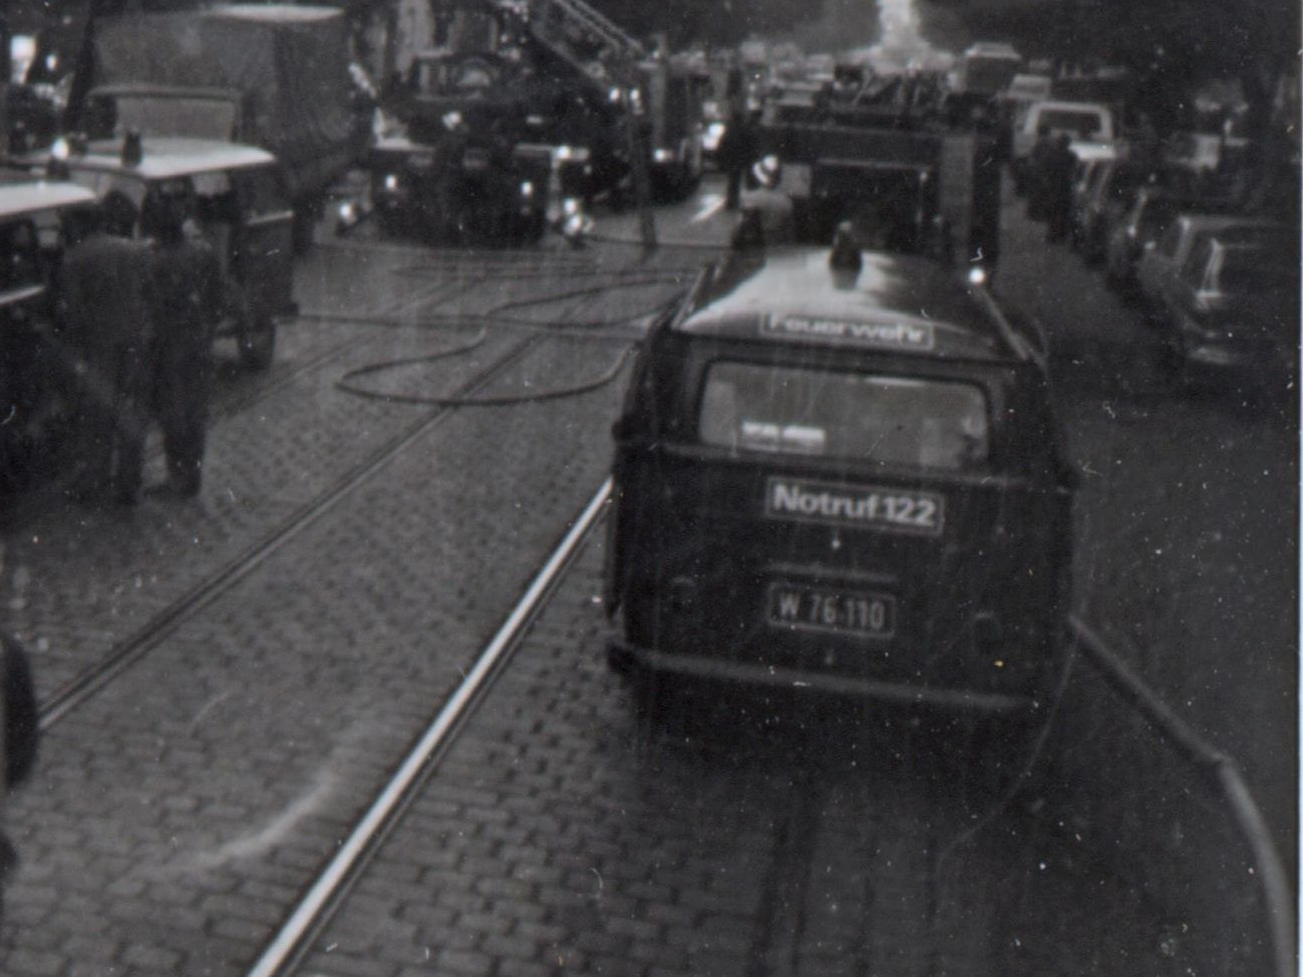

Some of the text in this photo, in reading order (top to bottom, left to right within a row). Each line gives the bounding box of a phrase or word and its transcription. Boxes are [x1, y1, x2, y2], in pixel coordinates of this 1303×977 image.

[769, 314, 926, 344] Feuerwehr
[773, 483, 937, 527] Notruf 122
[780, 592, 801, 617] W
